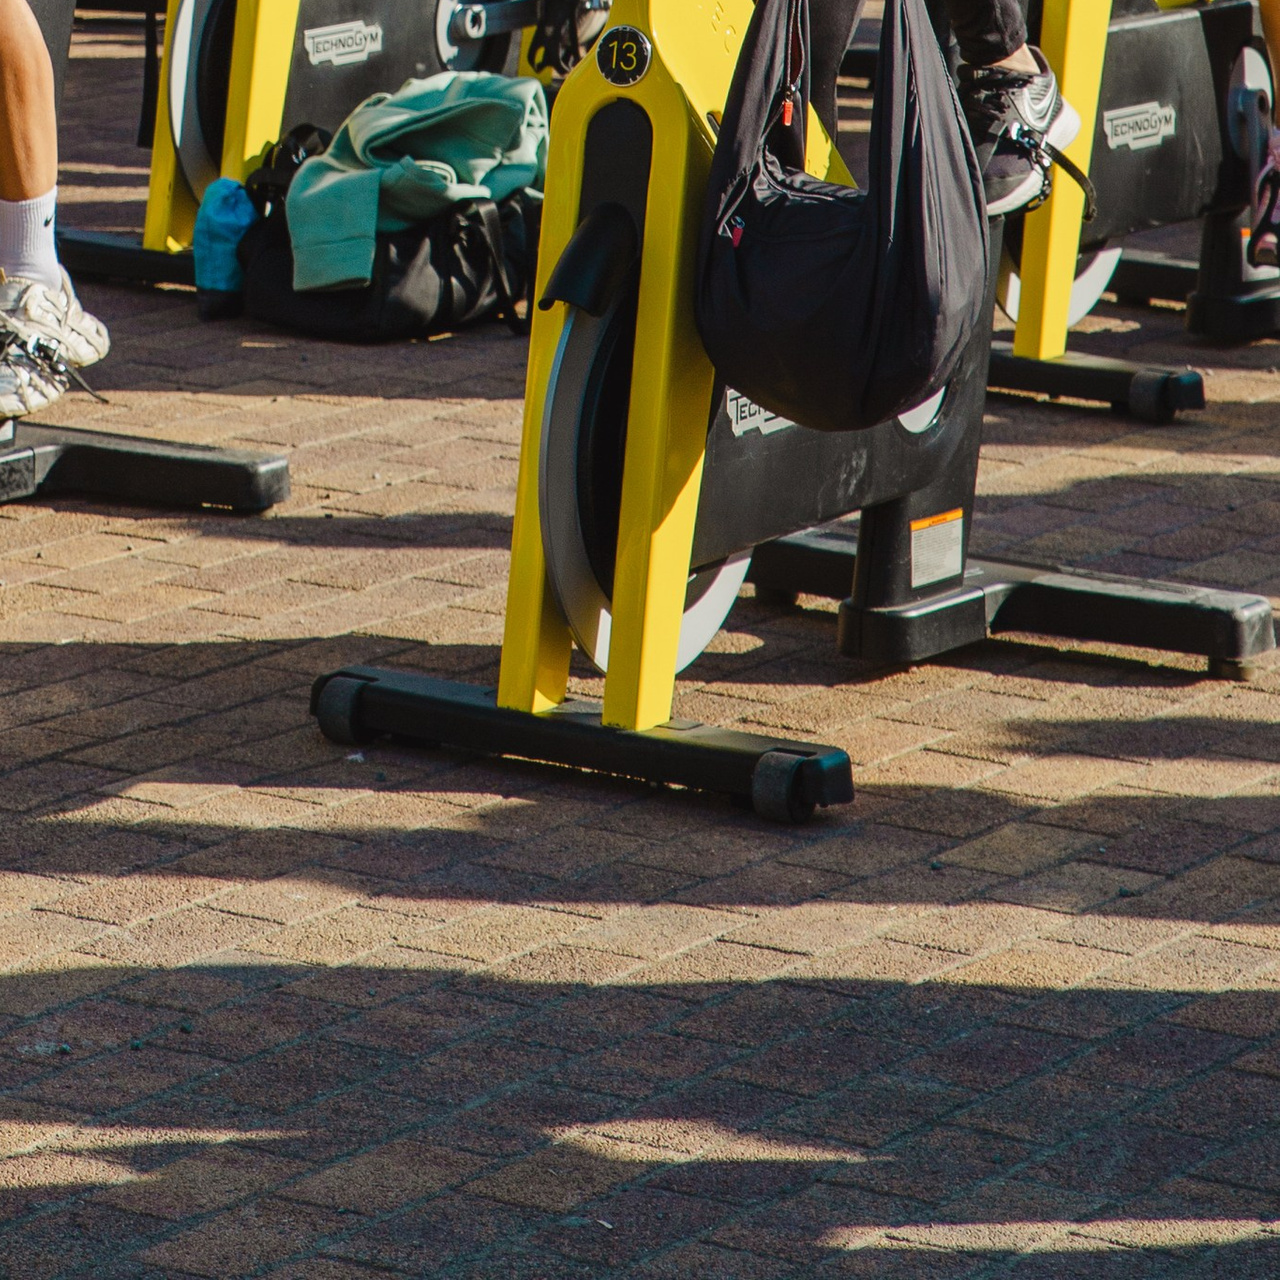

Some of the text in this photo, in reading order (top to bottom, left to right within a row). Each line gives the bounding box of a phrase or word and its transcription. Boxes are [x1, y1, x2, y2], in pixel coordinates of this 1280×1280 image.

[308, 28, 378, 57] TECHNOGYM
[609, 41, 637, 71] 13
[1106, 110, 1172, 140] TECHNOGYM
